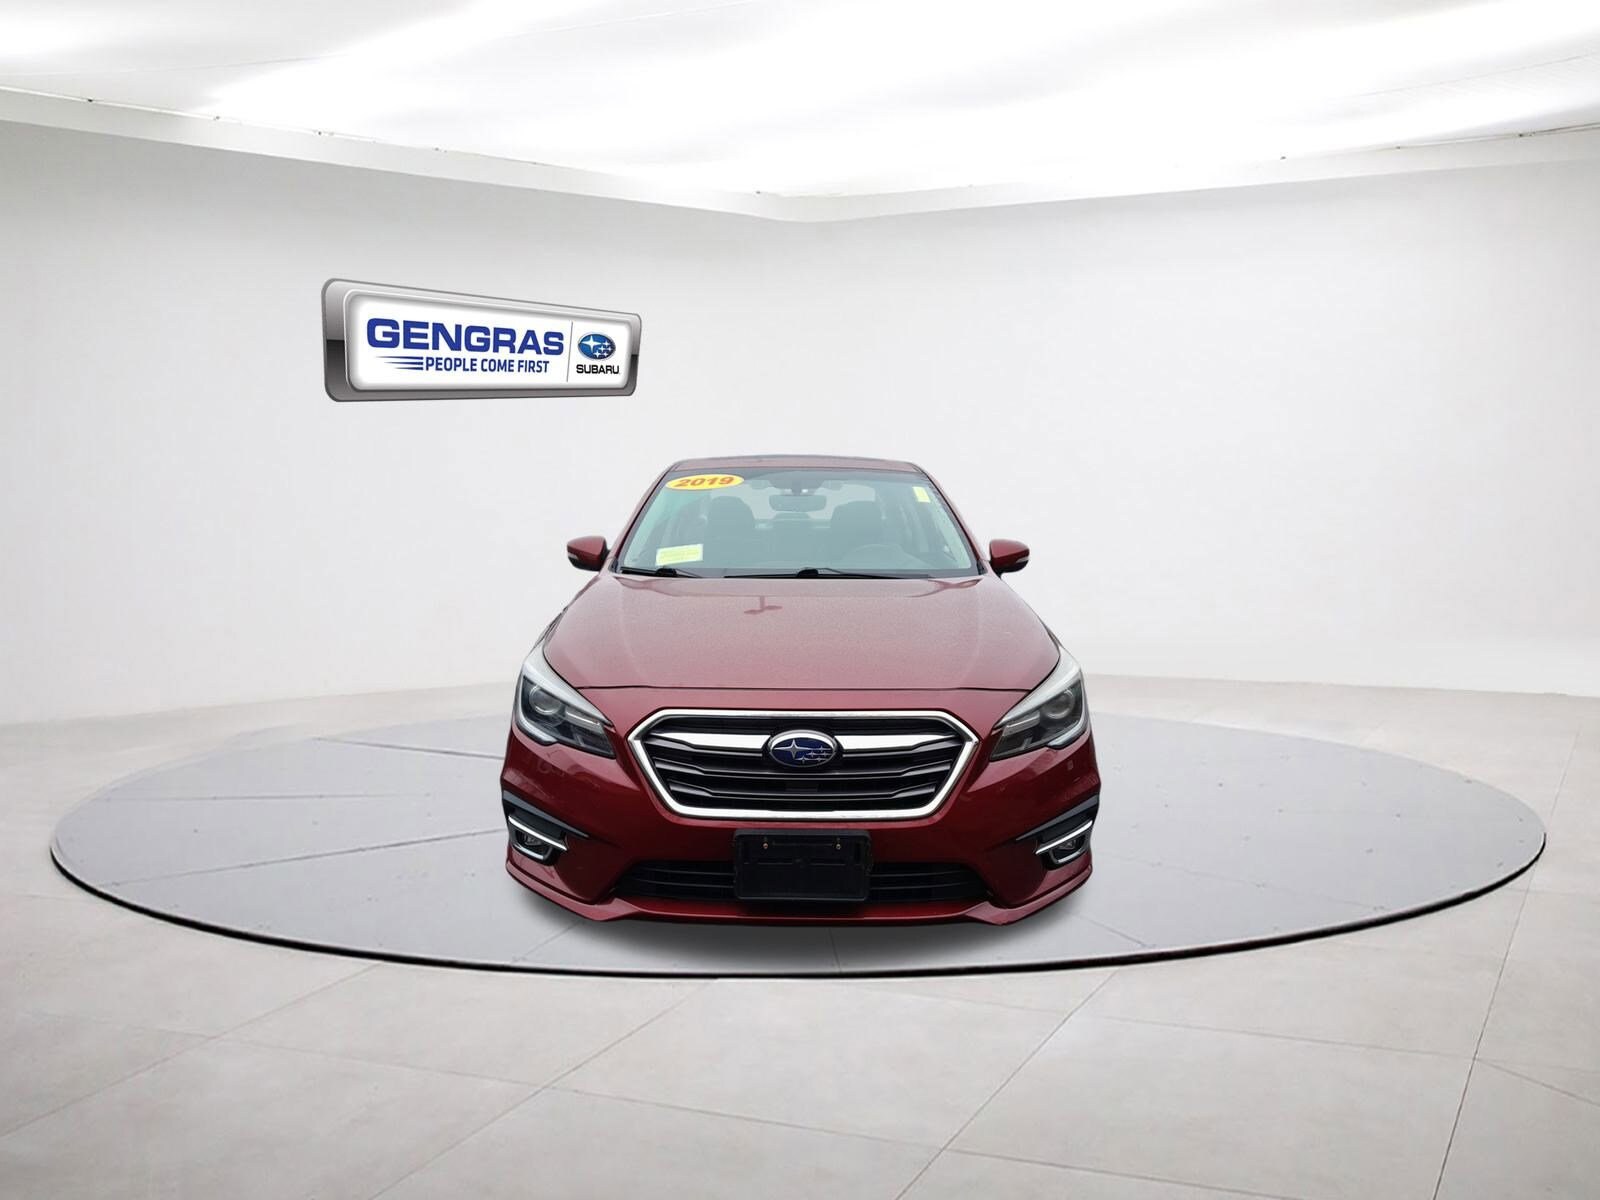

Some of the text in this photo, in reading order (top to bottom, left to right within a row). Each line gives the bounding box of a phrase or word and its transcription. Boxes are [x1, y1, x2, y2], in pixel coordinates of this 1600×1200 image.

[366, 317, 564, 356] GENGRAS
[425, 356, 550, 373] PEOPLE COME FIRST
[576, 363, 620, 375] SUBARU
[675, 475, 735, 488] 2019
